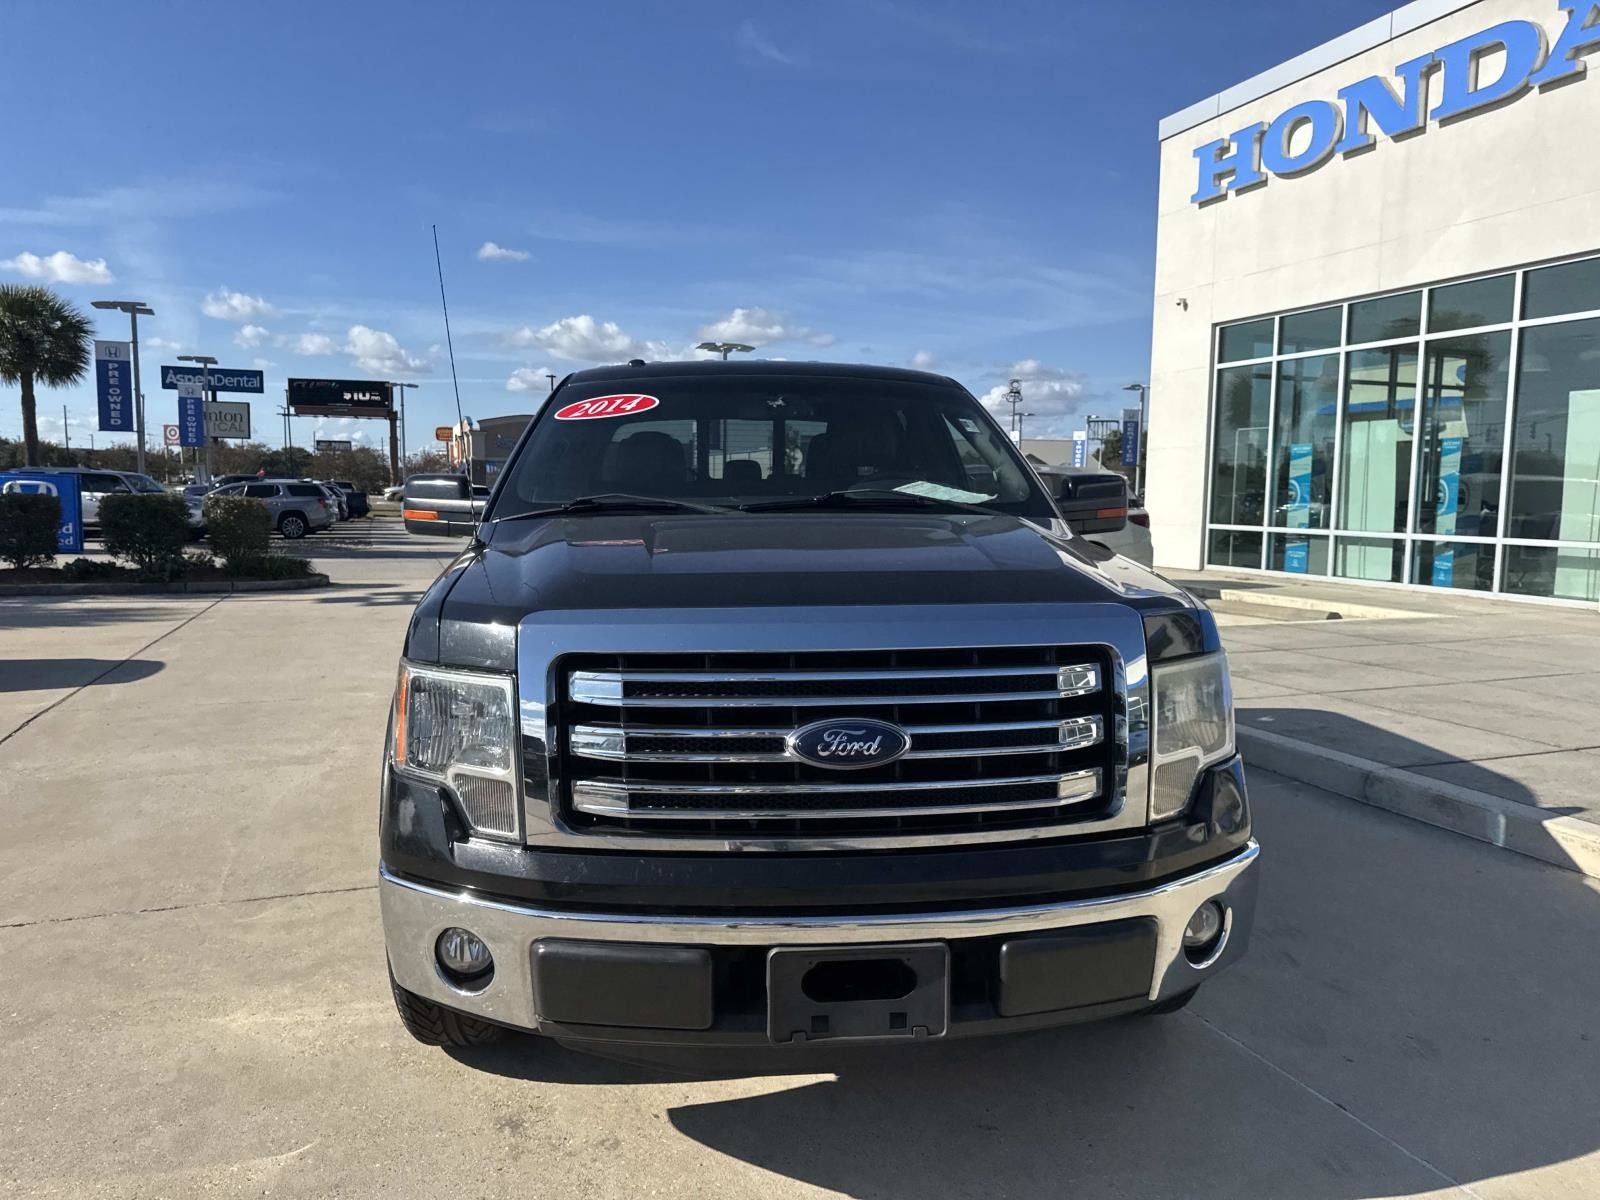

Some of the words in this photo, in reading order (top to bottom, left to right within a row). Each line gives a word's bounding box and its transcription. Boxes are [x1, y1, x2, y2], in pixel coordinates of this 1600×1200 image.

[203, 410, 243, 423] nton
[568, 397, 645, 418] 2014
[818, 729, 882, 756] Ford
